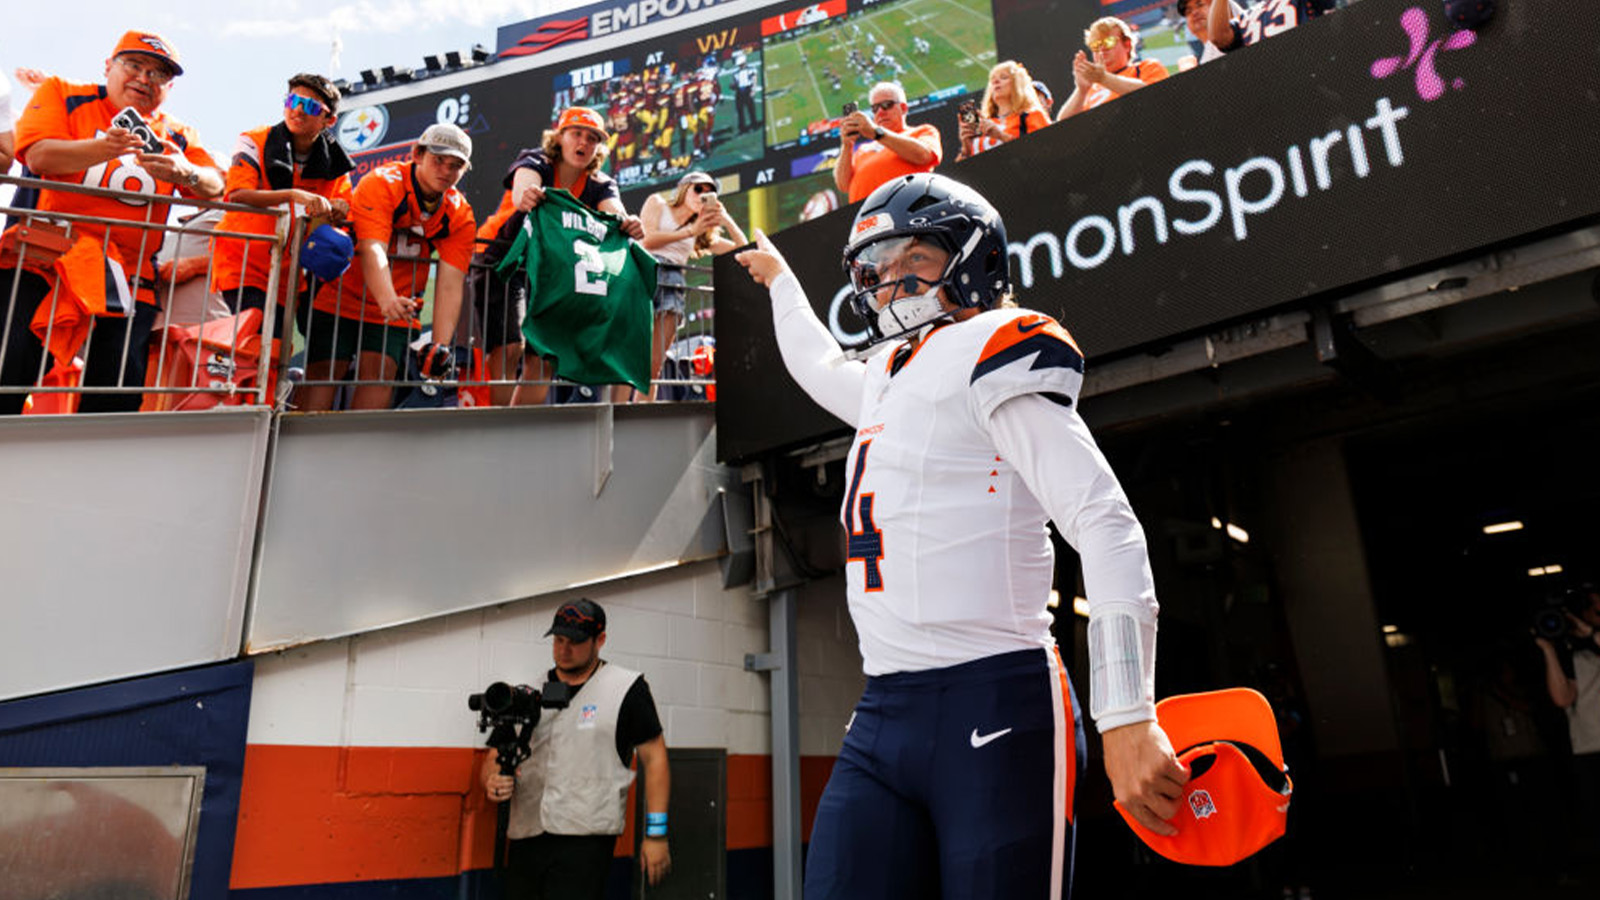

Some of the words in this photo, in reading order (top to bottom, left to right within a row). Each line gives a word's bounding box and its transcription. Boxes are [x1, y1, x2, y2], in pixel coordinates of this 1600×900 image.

[592, 0, 739, 37] EMPO
[646, 52, 664, 66] AT
[756, 168, 775, 185] AT
[828, 97, 1409, 346] CmonSpirit
[573, 239, 609, 296] 2
[844, 438, 885, 592] 4
